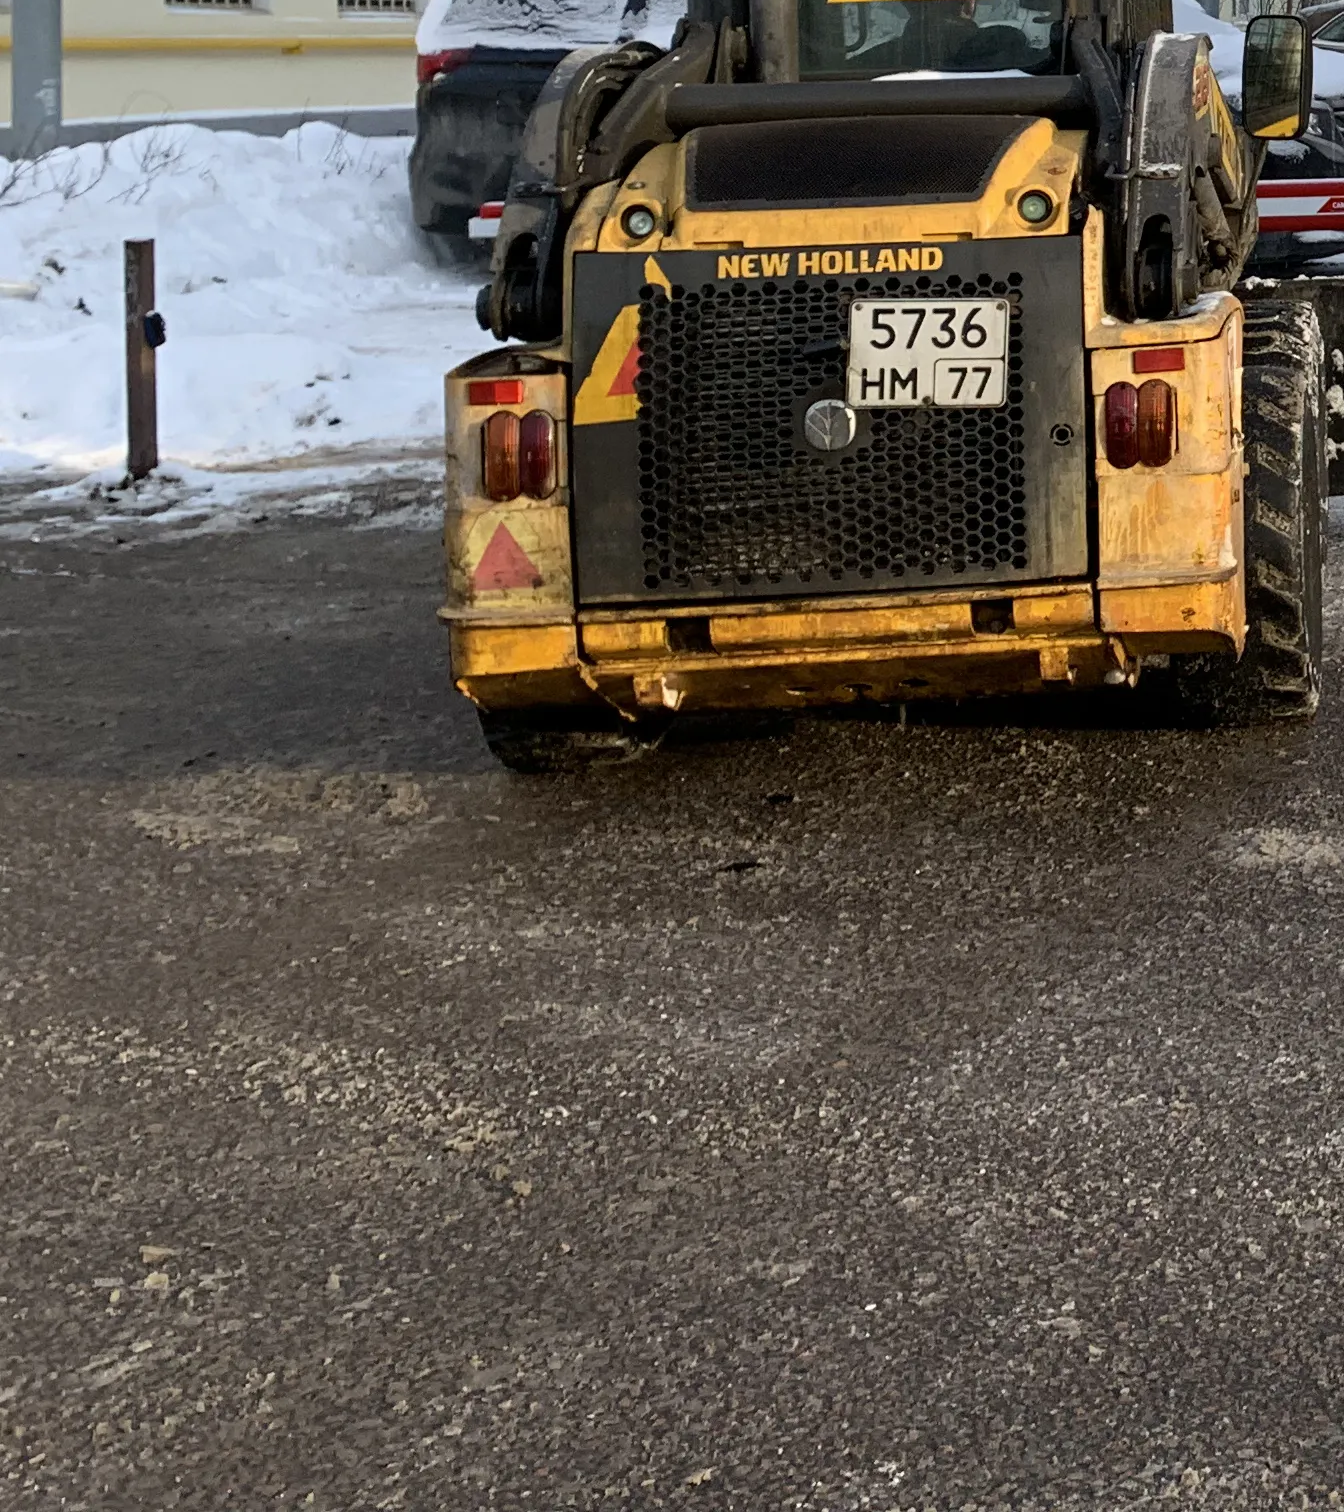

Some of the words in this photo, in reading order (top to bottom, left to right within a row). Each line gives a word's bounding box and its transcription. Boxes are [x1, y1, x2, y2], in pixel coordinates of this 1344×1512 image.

[717, 252, 790, 279] NEW
[798, 246, 943, 276] HOLLAND
[869, 307, 988, 350] 5736
[948, 366, 993, 399] 77
